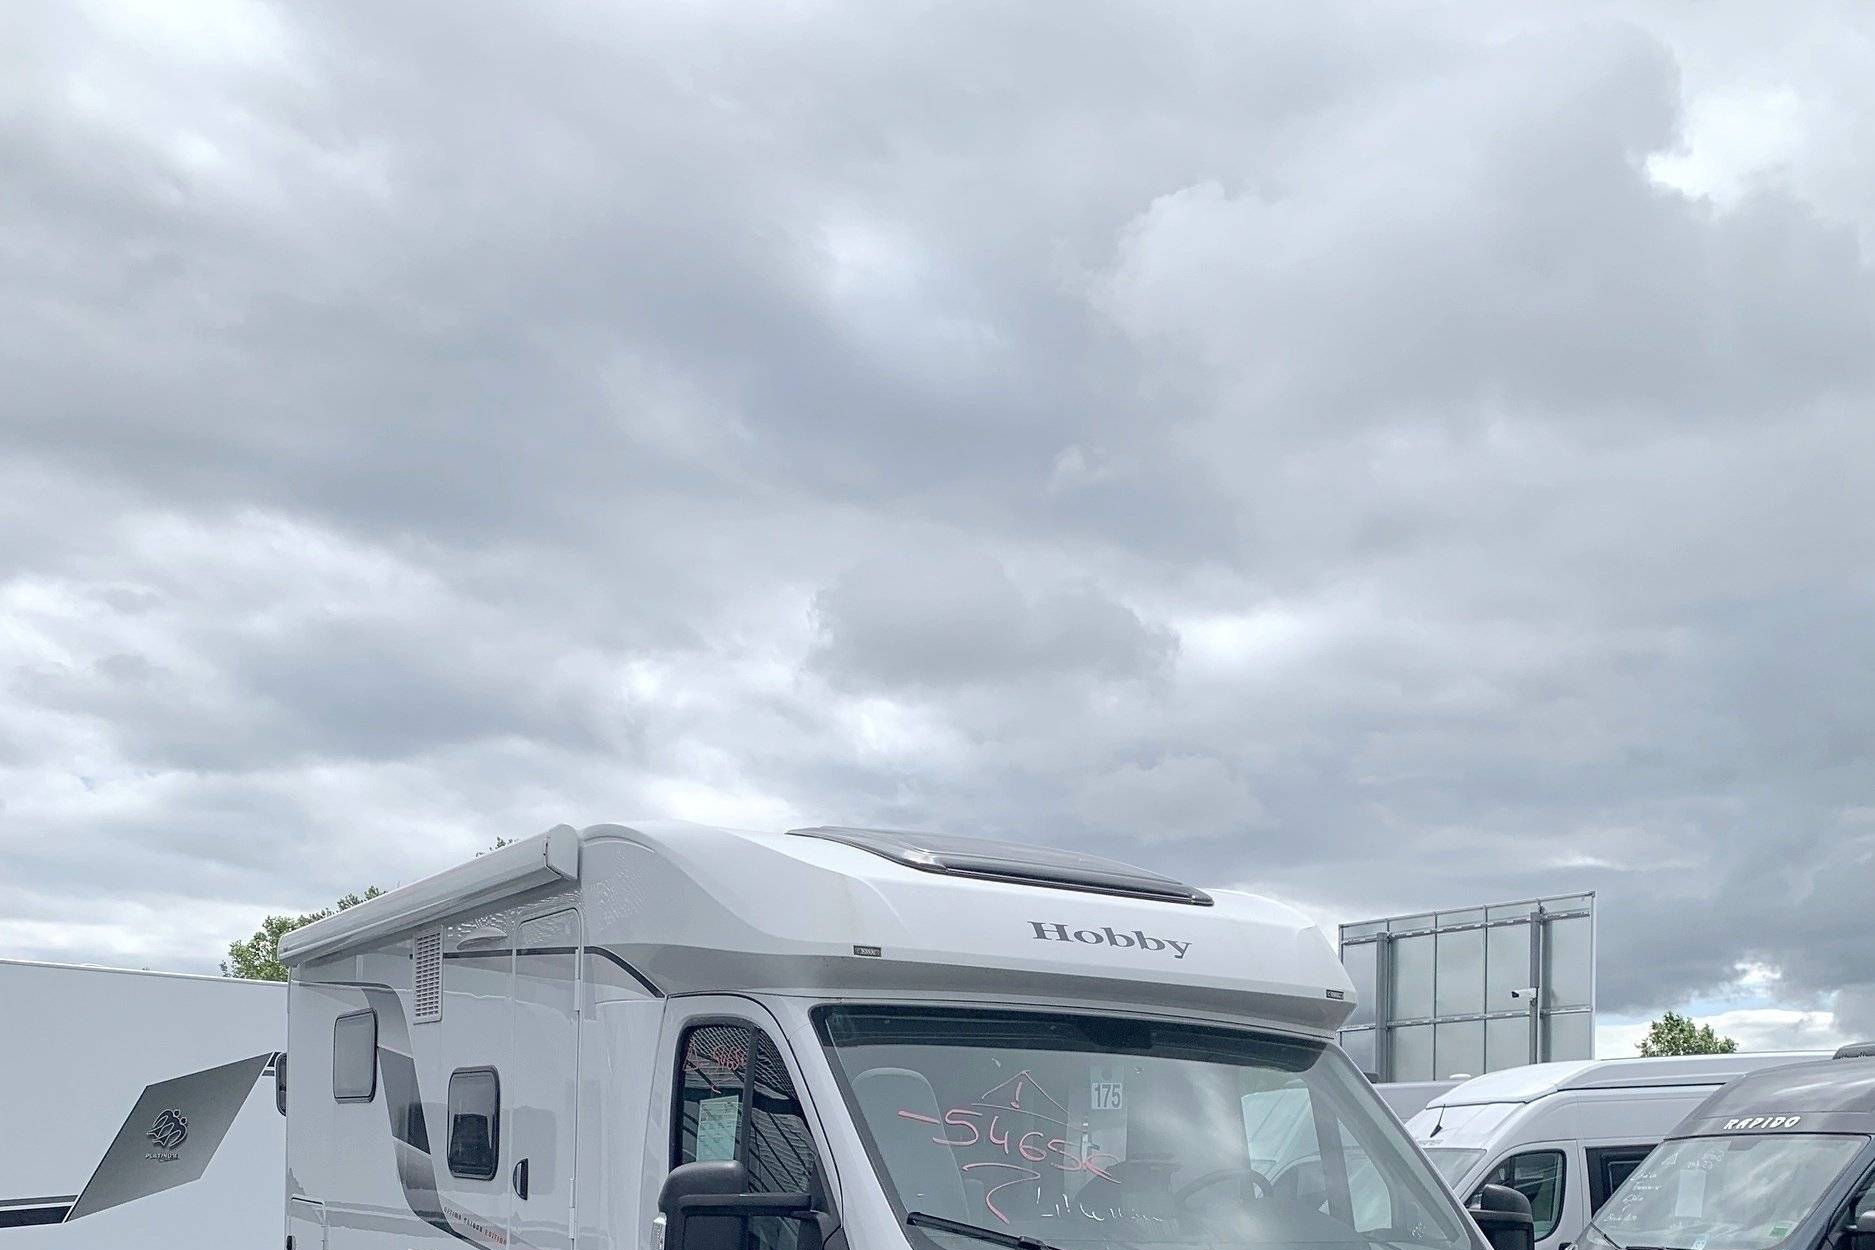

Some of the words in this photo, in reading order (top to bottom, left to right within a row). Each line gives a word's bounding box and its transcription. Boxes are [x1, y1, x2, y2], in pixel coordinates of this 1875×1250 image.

[1027, 921, 1193, 959] Hobby
[1094, 1083, 1121, 1109] 175
[1723, 1115, 1801, 1130] RAPIDO
